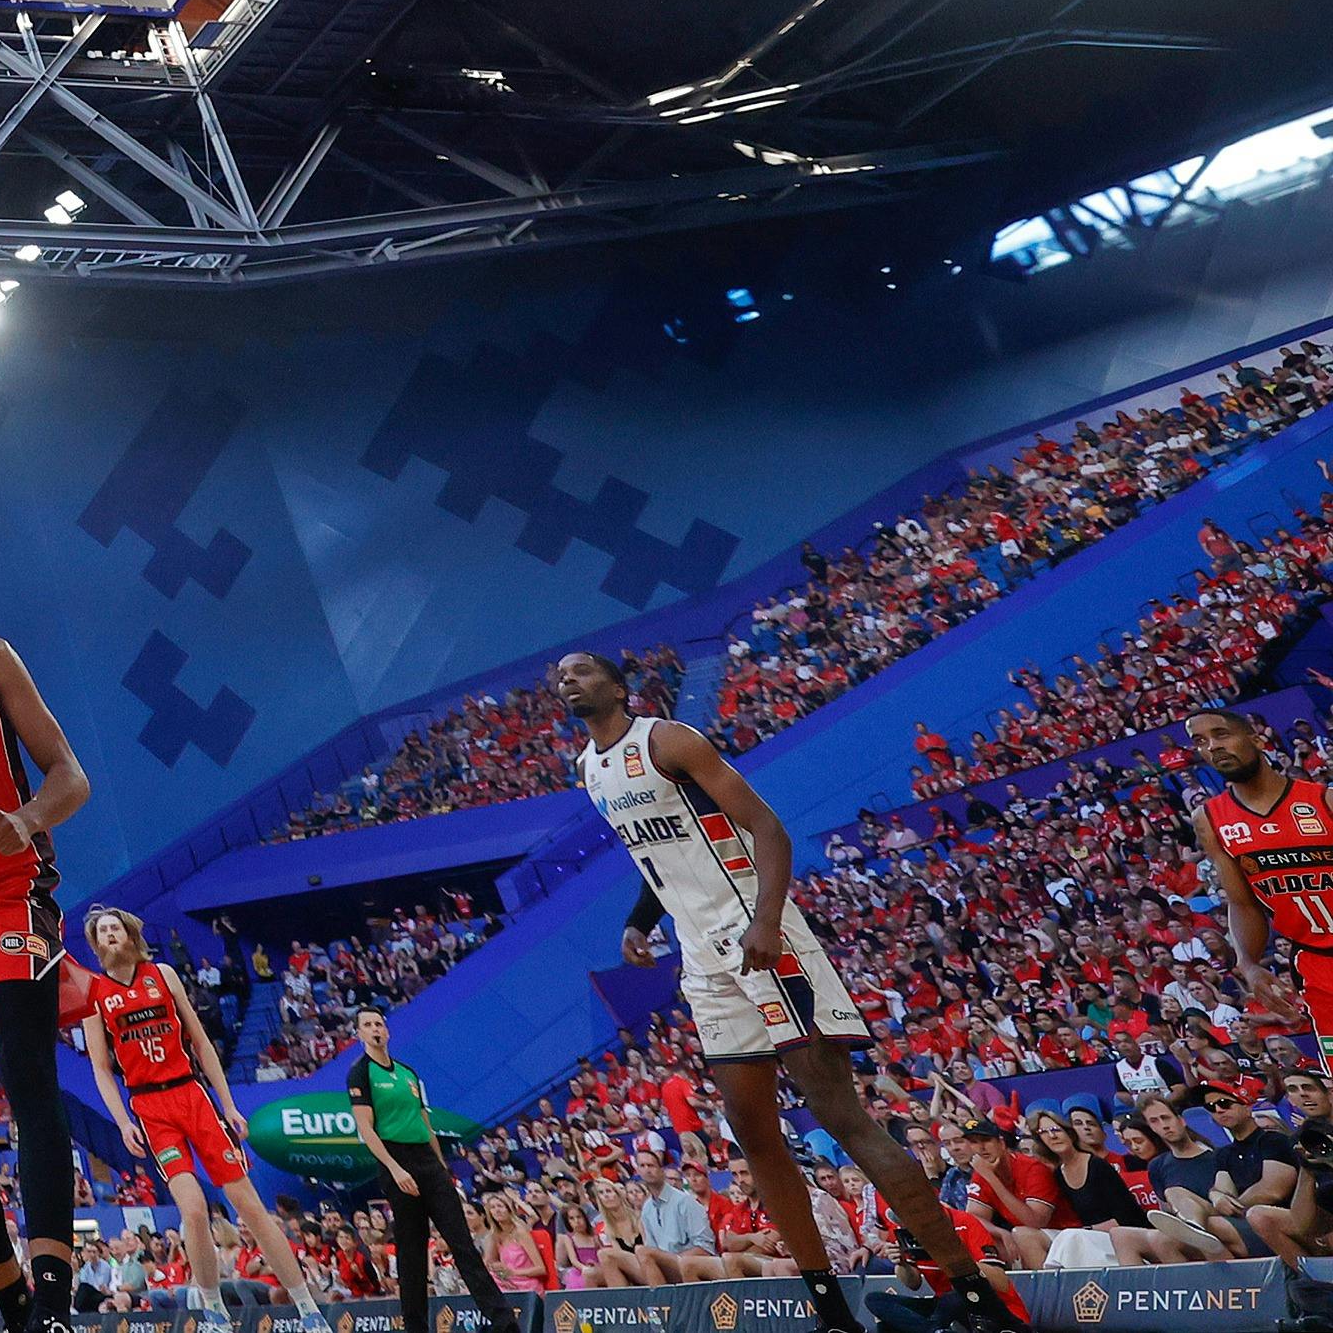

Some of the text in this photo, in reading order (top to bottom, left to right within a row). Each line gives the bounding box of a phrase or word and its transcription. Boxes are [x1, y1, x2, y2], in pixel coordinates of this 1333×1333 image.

[609, 788, 658, 813] walker
[639, 856, 664, 890] 1
[1292, 895, 1333, 934] 11
[139, 1037, 165, 1063] 45
[288, 1152, 354, 1169] moving
[744, 1299, 817, 1318] PENTAN
[1118, 1288, 1262, 1311] PENTANET
[582, 1306, 672, 1326] PENTANET
